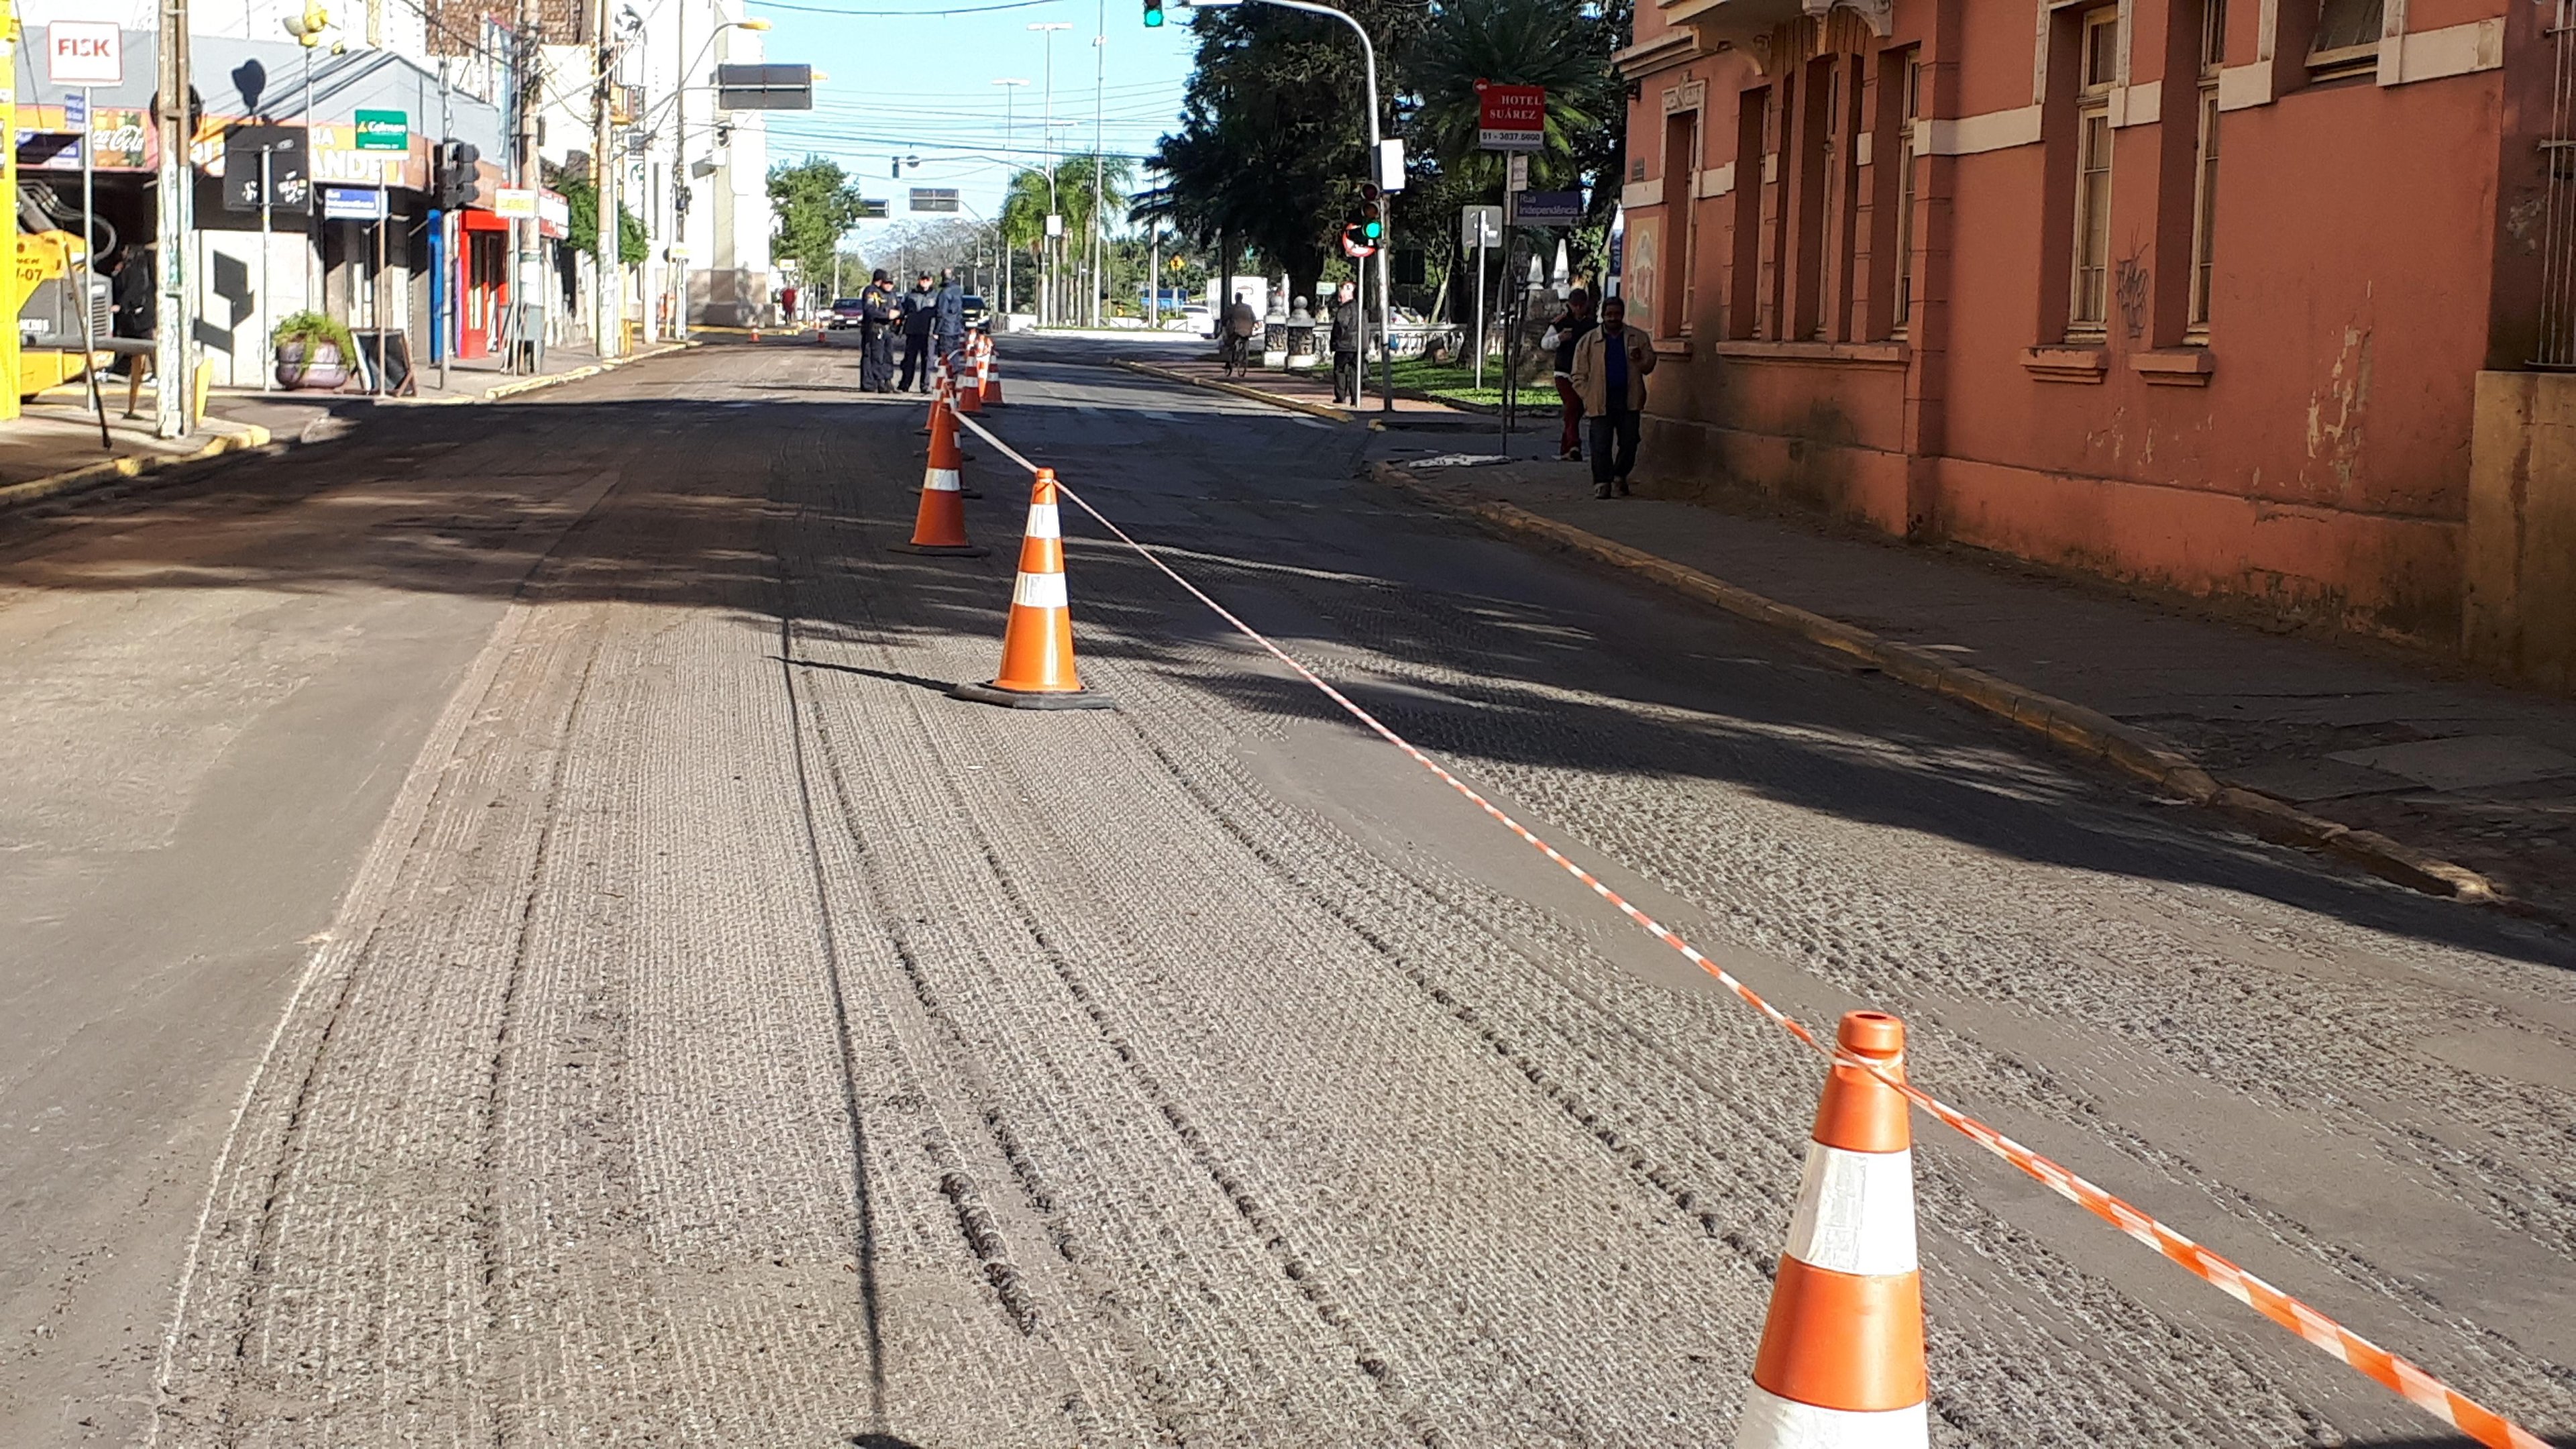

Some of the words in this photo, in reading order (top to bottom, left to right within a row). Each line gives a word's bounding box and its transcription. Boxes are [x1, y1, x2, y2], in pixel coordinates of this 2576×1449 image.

[58, 38, 111, 57] FISK
[1501, 95, 1542, 106] HOTEL
[1489, 108, 1537, 120] SUÁREZ
[1519, 194, 1537, 203] Rua
[1519, 205, 1578, 216] Independência
